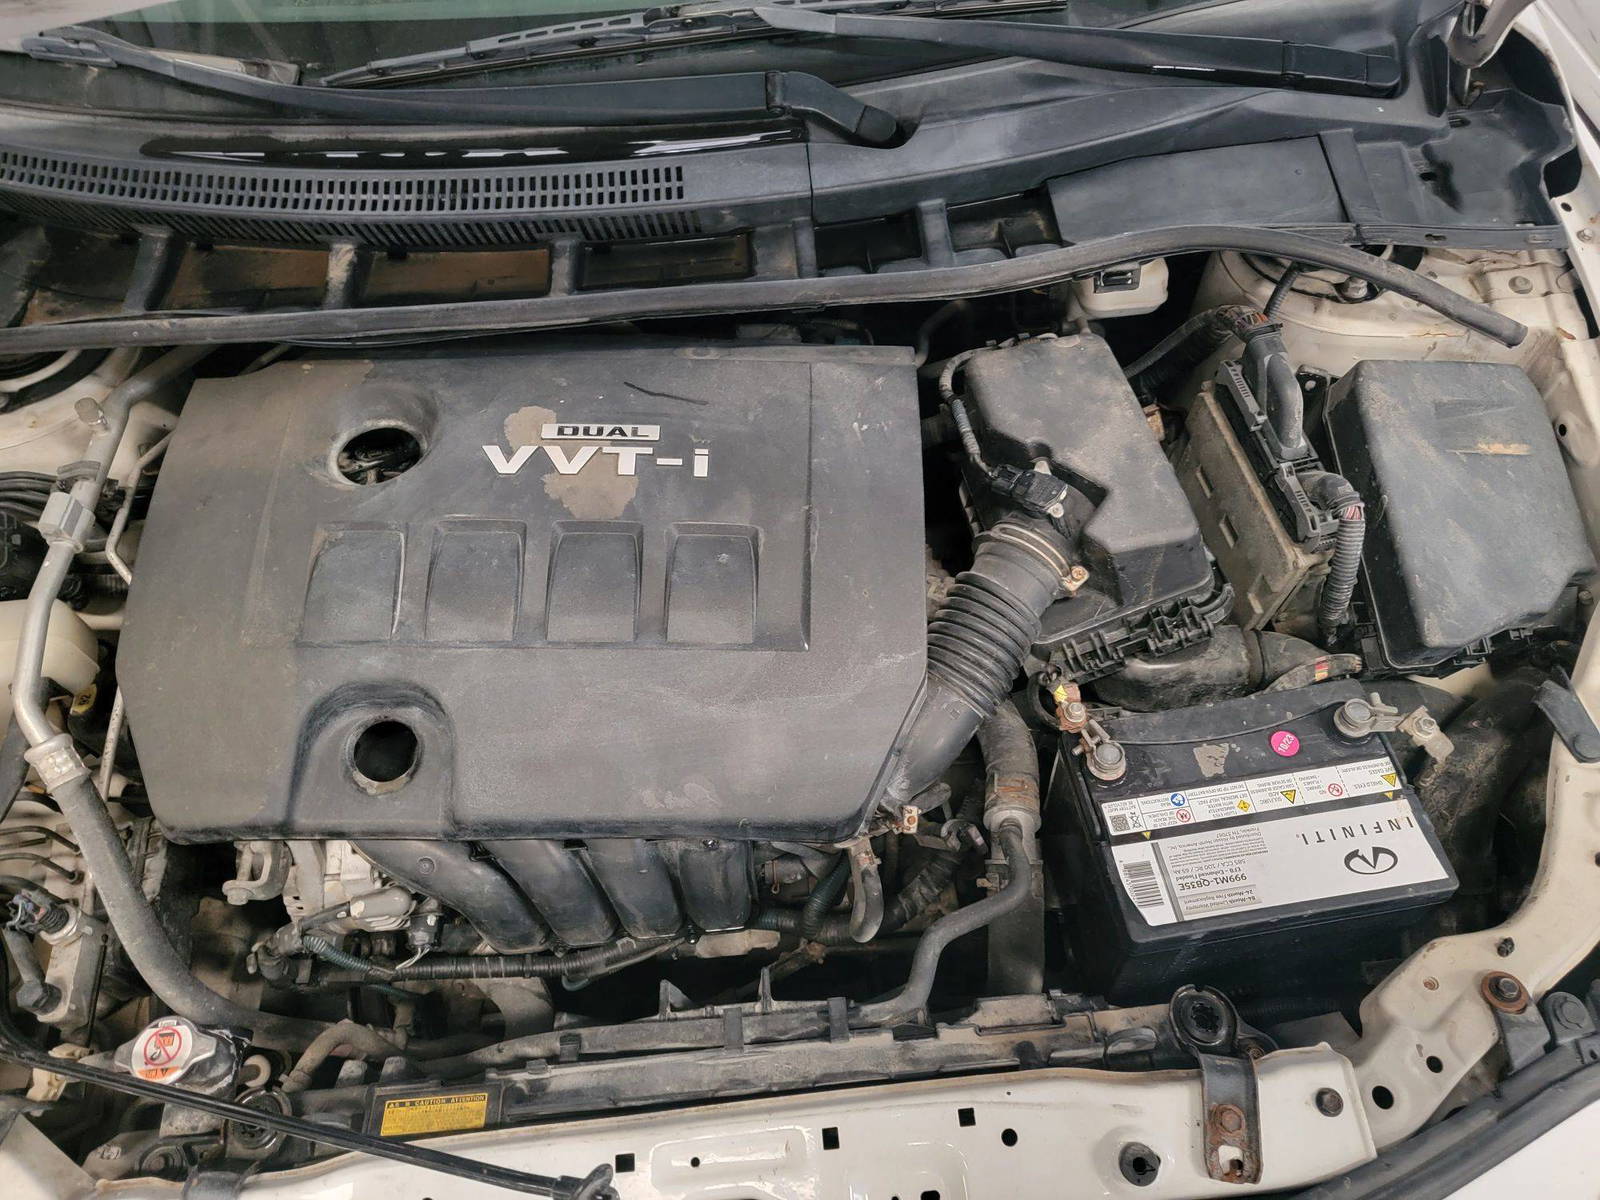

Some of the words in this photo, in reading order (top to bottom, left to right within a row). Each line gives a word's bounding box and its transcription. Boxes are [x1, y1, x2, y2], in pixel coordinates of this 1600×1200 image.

[556, 425, 649, 437] DUAL
[481, 445, 709, 477] VVT-i
[1300, 816, 1414, 844] INFINITI
[1174, 873, 1197, 881] Flooded
[1176, 871, 1247, 890] 999M1-QB35E
[1197, 869, 1224, 877] Enhanced
